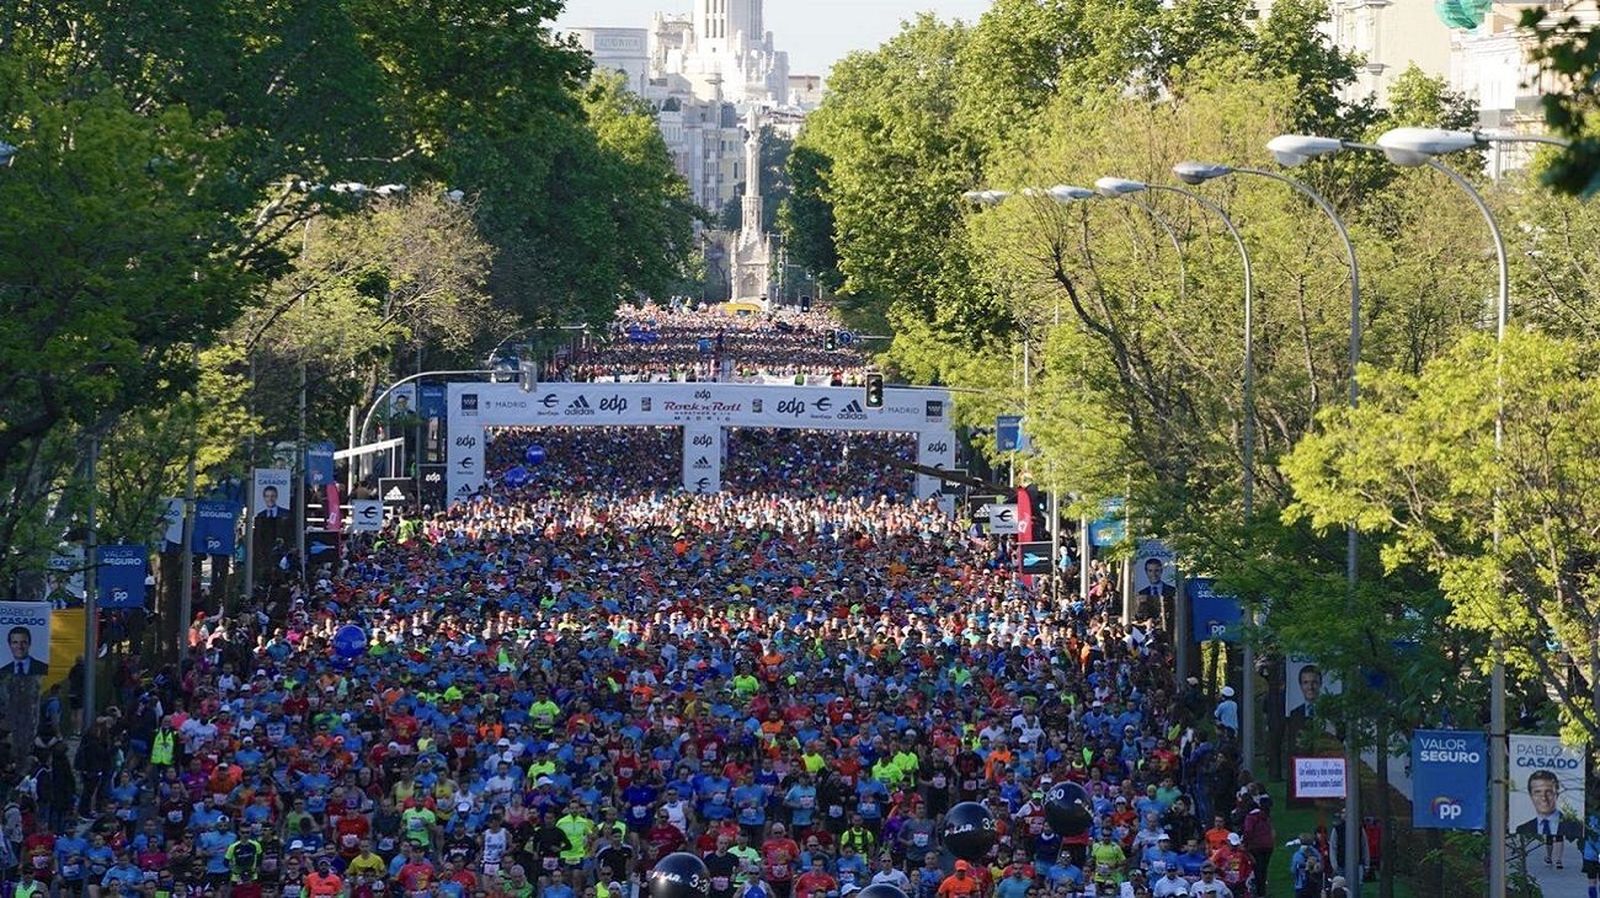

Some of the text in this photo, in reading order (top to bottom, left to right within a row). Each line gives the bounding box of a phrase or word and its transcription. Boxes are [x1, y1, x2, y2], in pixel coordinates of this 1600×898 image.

[495, 401, 527, 409] MADRID
[599, 394, 628, 415] edp
[776, 397, 806, 419] edp
[888, 406, 920, 415] MADRID
[564, 408, 595, 416] adidas
[836, 412, 868, 420] adidas
[455, 434, 477, 449] edp
[692, 434, 713, 448] edp
[927, 440, 948, 455] edp
[425, 472, 441, 484] edp
[208, 540, 221, 549] pp
[113, 591, 128, 602] pp
[0, 617, 46, 626] CASADO
[1420, 737, 1467, 751] VALOR
[1516, 744, 1563, 756] PABLO
[1420, 750, 1481, 764] SEGURO
[1516, 756, 1579, 770] CASADO
[1439, 803, 1462, 820] pp
